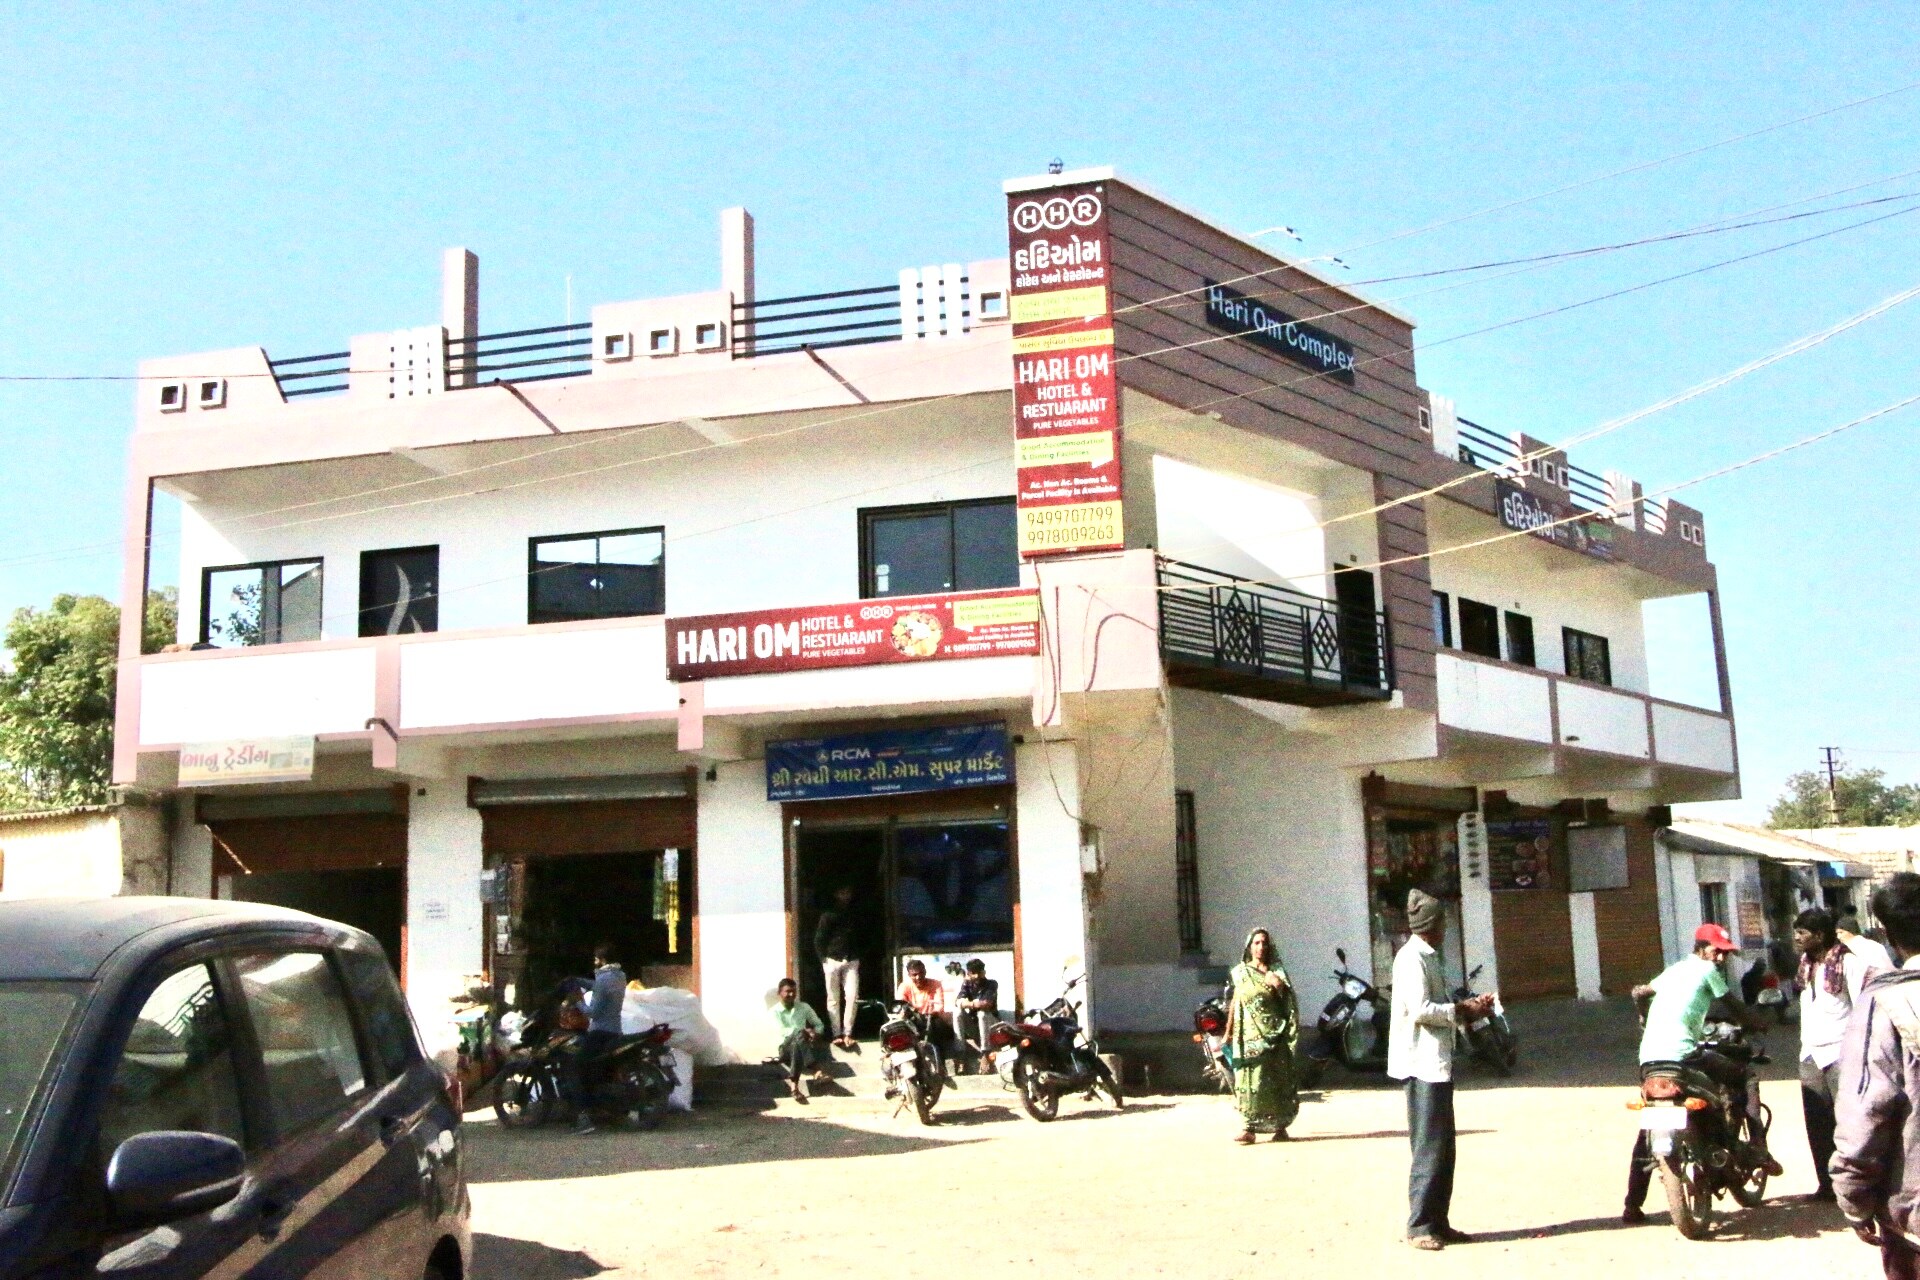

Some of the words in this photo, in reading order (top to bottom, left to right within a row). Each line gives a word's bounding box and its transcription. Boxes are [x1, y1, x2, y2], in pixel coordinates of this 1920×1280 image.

[1016, 196, 1100, 232] HHR
[1015, 235, 1101, 271] હરિઓમ
[1041, 270, 1060, 284] અને
[1210, 287, 1248, 326] Hari
[1254, 307, 1282, 340] Om
[1286, 323, 1354, 373] Complex
[1020, 358, 1070, 383] HARI
[1076, 353, 1109, 378] OM
[1038, 384, 1078, 400] HOTEL
[1081, 382, 1092, 396] &
[1023, 398, 1108, 418] RESTUARANT
[1033, 422, 1052, 430] PURE
[1054, 417, 1099, 428] VEGETABLES
[1028, 506, 1113, 526] 9499707799
[1028, 525, 1114, 544] 9978009263
[802, 616, 841, 632] HOTEL
[844, 614, 854, 628] &
[677, 626, 747, 664] HARI
[754, 621, 800, 658] OM
[802, 629, 884, 648] RESTUARANT
[802, 650, 821, 659] PURE
[823, 646, 866, 656] VEGETABLES
[831, 748, 870, 761] RCM
[772, 767, 790, 788] શ્રી
[929, 760, 962, 781] સુપર
